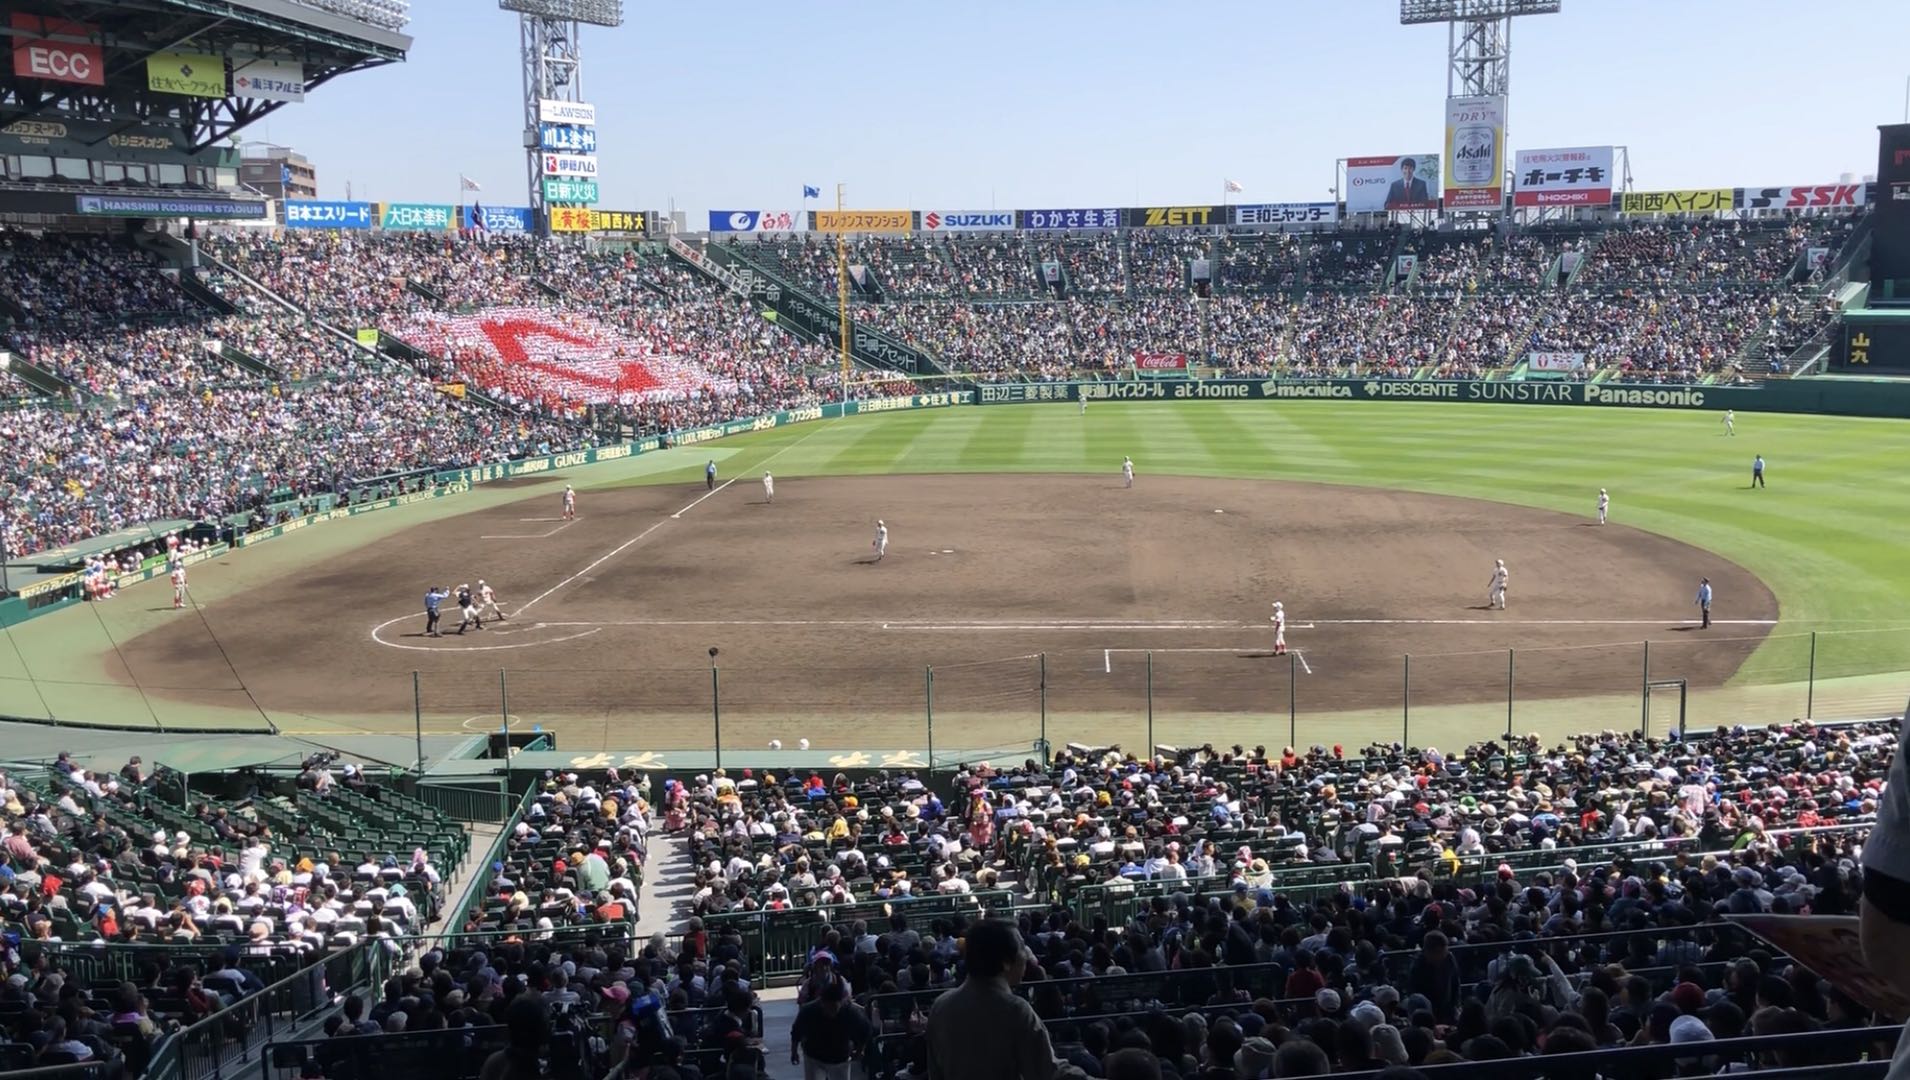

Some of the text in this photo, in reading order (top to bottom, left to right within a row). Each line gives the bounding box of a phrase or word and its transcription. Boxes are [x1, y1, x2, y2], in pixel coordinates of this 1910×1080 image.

[30, 47, 90, 79] ECC
[151, 76, 226, 95] 住友ベークライト
[553, 105, 593, 120] LAWSON
[120, 135, 174, 149] シミズオクト
[544, 127, 596, 152] 川上塗料
[1456, 144, 1491, 160] Asahi
[560, 159, 596, 173] 伊藤ハム
[1523, 167, 1605, 186] ホーチキ
[547, 182, 596, 200] 日新火災
[1544, 193, 1588, 201] HOCHIKI
[1785, 184, 1860, 207] SSK
[104, 201, 264, 214] HANSHIN KOSHIEN STADIUM
[1624, 191, 1732, 211] 関西ペイント
[287, 205, 369, 222] 日本エスリード
[389, 207, 448, 226] 大日本塗料
[488, 214, 525, 229] ろうきん
[762, 212, 793, 230] 白鶴
[945, 214, 1012, 227] SUZUKI
[1031, 210, 1117, 228] わかさ生活
[1144, 207, 1213, 225] ZETT
[1241, 208, 1330, 223] 三和シャッター
[726, 259, 780, 301] 大同生命
[1850, 332, 1870, 364] 山九
[1142, 355, 1179, 368] Coca-Cola
[982, 384, 1068, 401] 田辺三菱製薬
[1078, 382, 1164, 398] 東進ハイスクール
[1175, 380, 1249, 397] at home
[1381, 383, 1458, 397] DESCENTE
[1469, 384, 1573, 401] SUNSTAR
[1583, 384, 1705, 406] Panasonic
[554, 451, 587, 468] GUNZE
